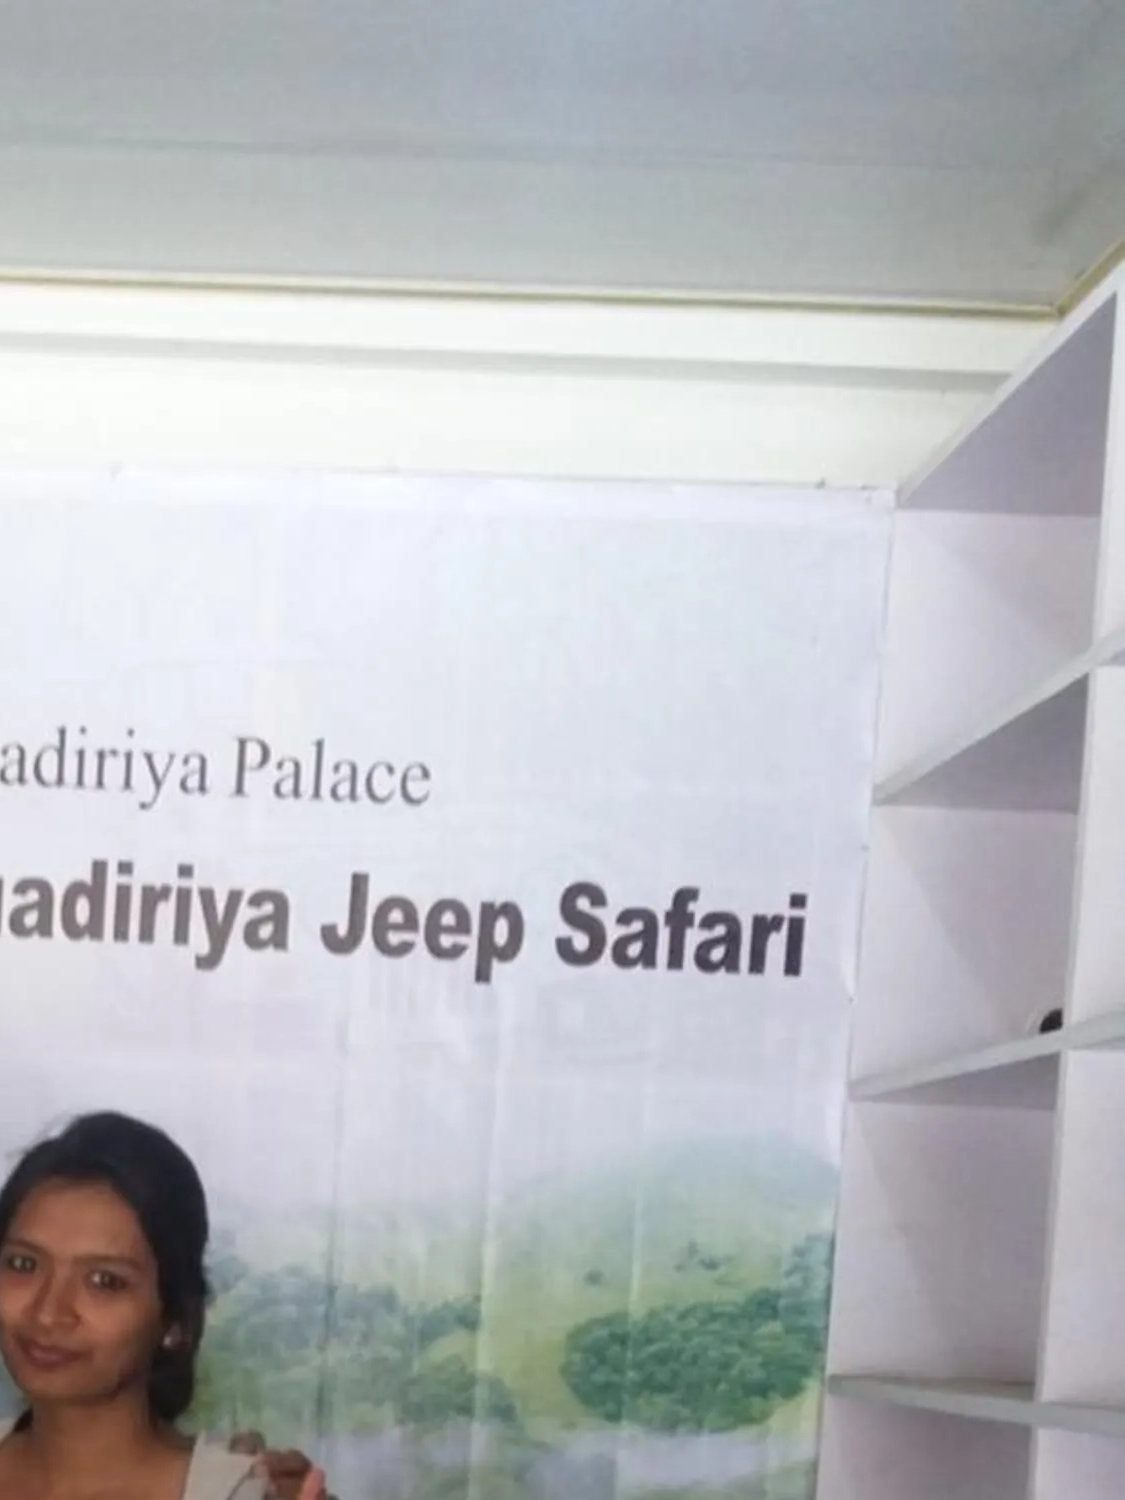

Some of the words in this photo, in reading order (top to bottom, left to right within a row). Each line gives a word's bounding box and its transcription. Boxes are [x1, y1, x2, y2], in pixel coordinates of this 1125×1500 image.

[228, 735, 432, 808] Palace
[319, 870, 526, 986] Jeep
[554, 880, 809, 978] Safari
